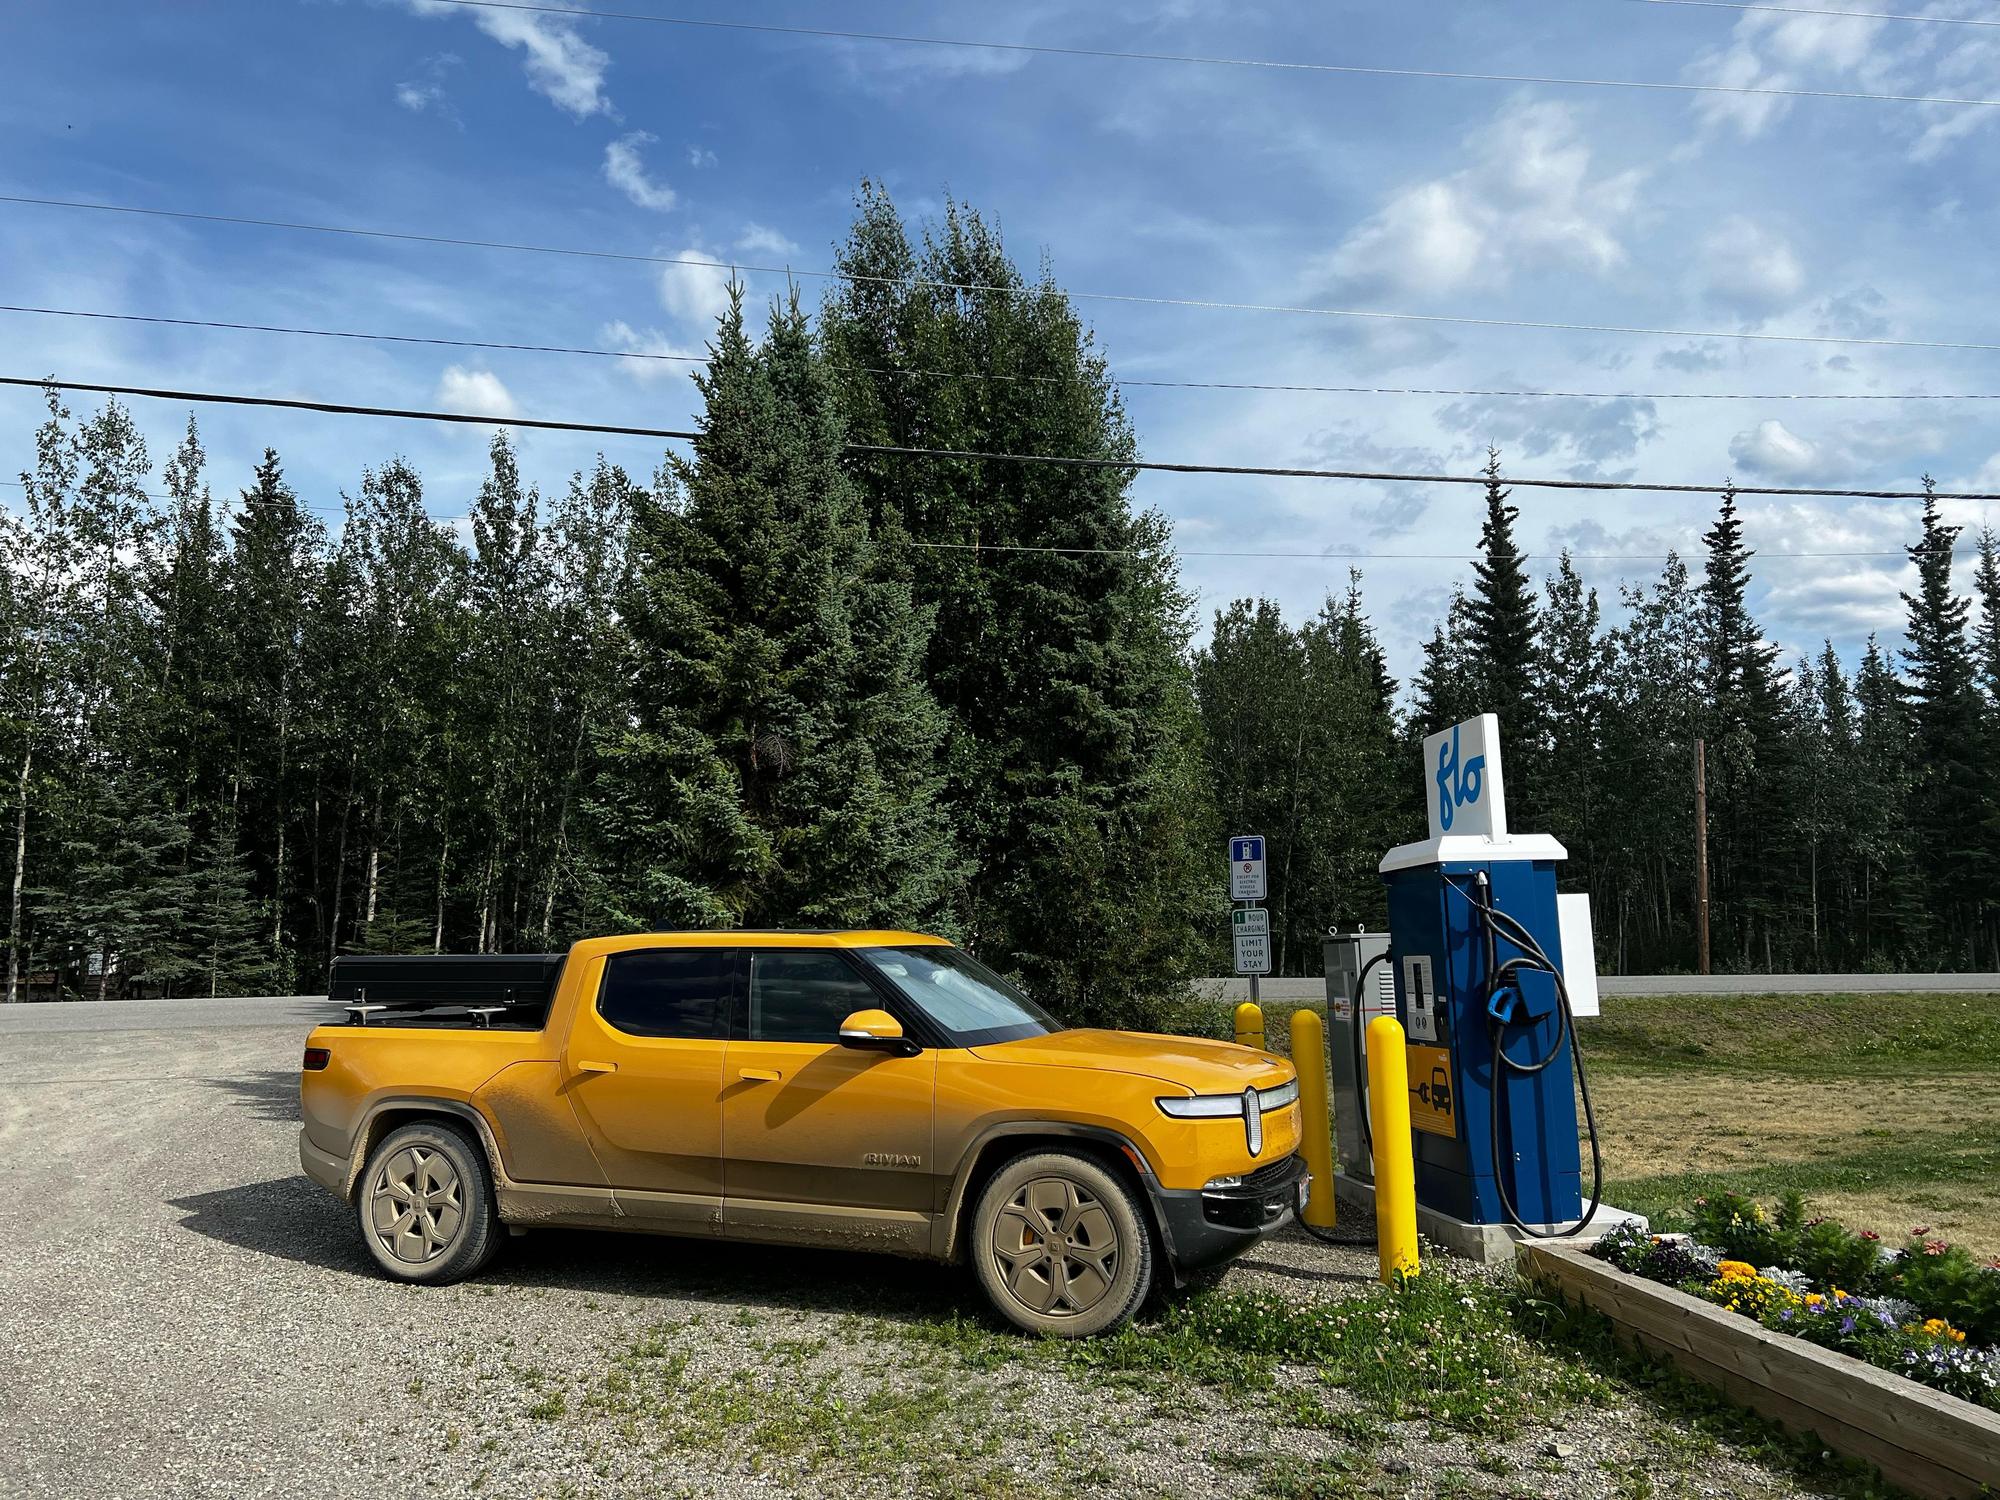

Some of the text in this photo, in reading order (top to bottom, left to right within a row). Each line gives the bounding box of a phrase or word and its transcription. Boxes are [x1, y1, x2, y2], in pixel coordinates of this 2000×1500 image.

[1436, 725, 1485, 831] flo
[1236, 925, 1265, 933] CHARGING
[1241, 939, 1263, 947] LIMIT
[864, 1152, 921, 1167] RIVIAN
